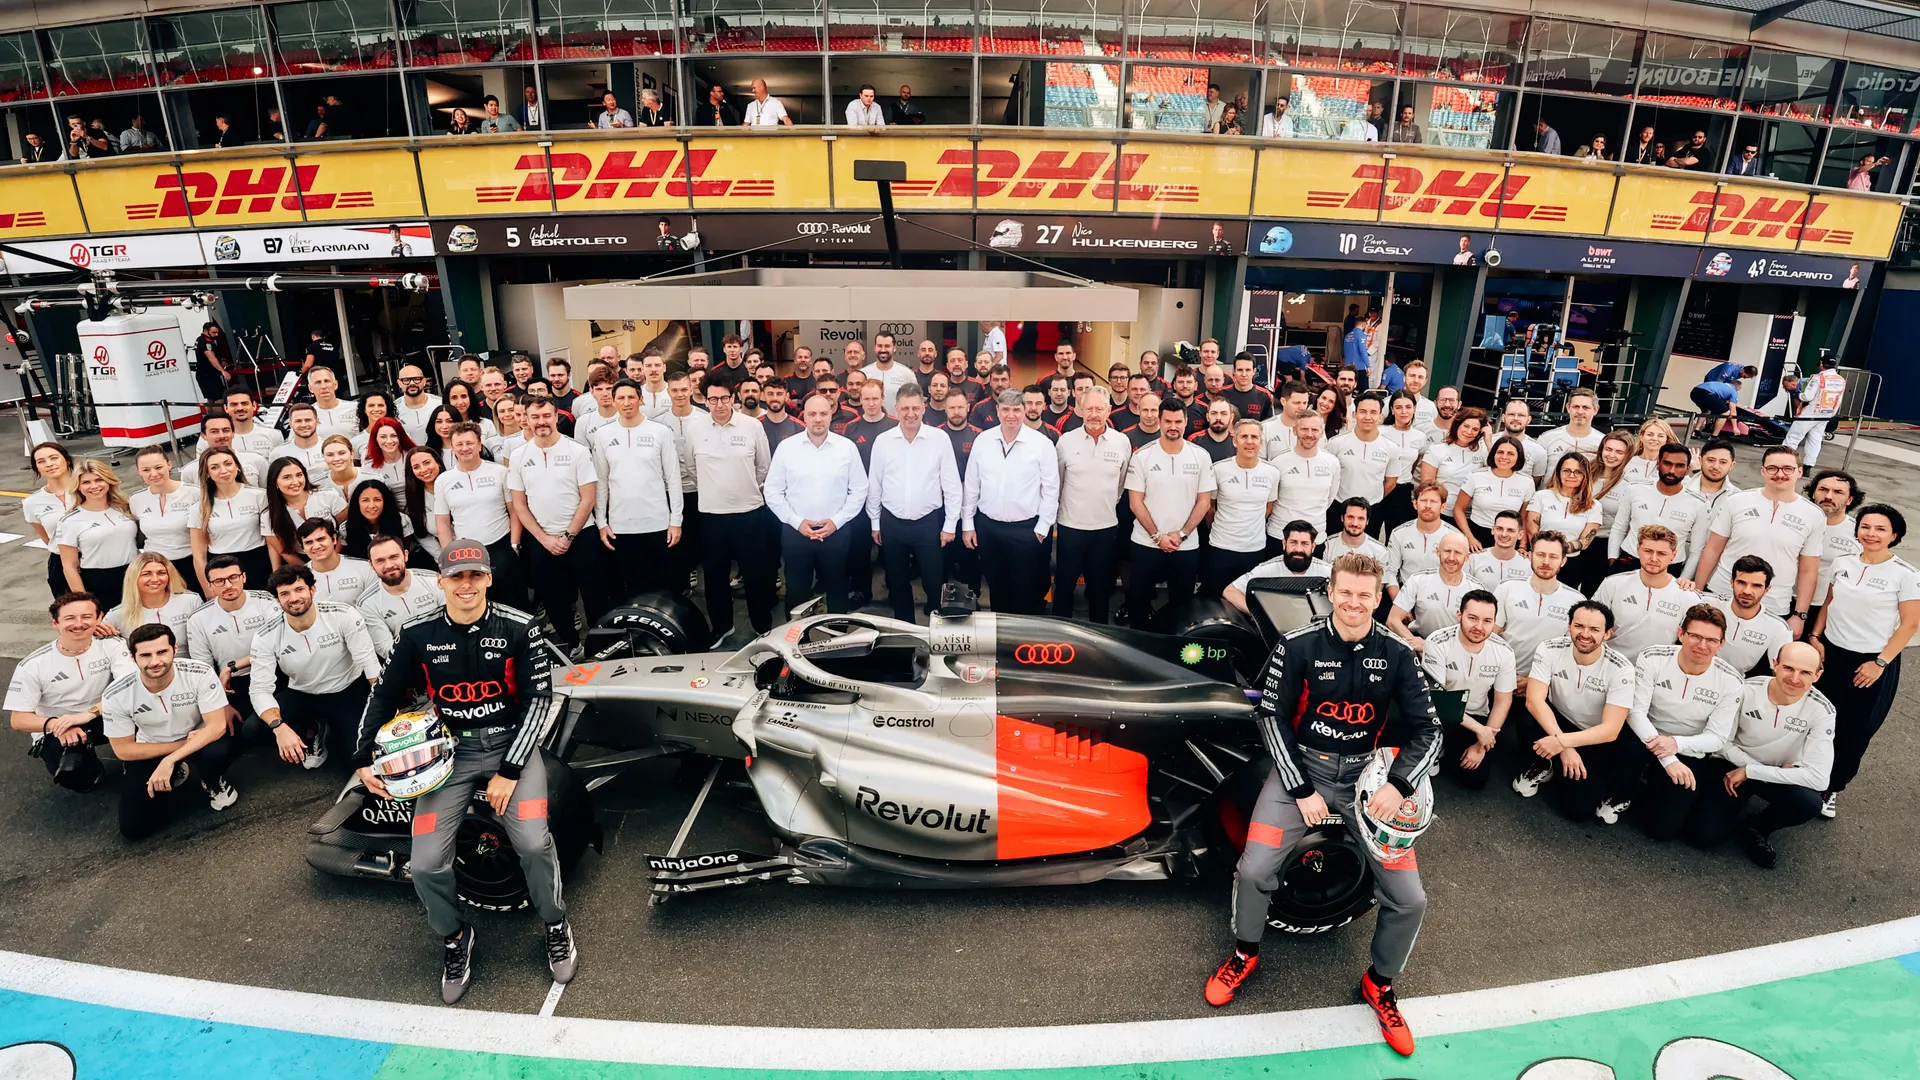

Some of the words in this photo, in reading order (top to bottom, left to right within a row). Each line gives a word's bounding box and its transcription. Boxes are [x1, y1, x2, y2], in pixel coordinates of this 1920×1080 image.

[514, 149, 733, 202] DHL
[931, 149, 1156, 202] DHL
[153, 164, 337, 219] DHL
[1344, 163, 1537, 219] DHL
[1679, 191, 1830, 242] DHL
[529, 223, 560, 240] Gabriel
[832, 223, 871, 234] Revolut
[1036, 225, 1064, 244] 27
[1072, 221, 1093, 237] Nico
[506, 227, 521, 247] 5
[531, 236, 628, 247] BORTOLETO
[1363, 234, 1388, 247] Pierre
[263, 237, 283, 254] 87
[291, 242, 370, 254] BEARMAN
[1072, 238, 1198, 249] HULKENBERG
[1339, 233, 1357, 255] 10
[89, 244, 127, 256] TGR
[1362, 246, 1413, 256] GASLY
[1595, 248, 1612, 257] BWT
[1747, 258, 1766, 278] 43
[1768, 259, 1788, 271] Franco
[1768, 269, 1833, 281] COLAPINTO
[90, 366, 116, 376] TGR
[143, 358, 177, 372] TGR
[1781, 520, 1803, 532] Revolut
[1828, 544, 1852, 554] Revolut
[1547, 612, 1568, 622] Revolut
[1656, 608, 1678, 619] Revolut
[613, 615, 623, 624] P
[627, 614, 674, 637] ZERO
[319, 639, 341, 649] Revolut
[943, 634, 971, 644] visit
[1741, 636, 1765, 646] Revolut
[426, 643, 457, 651] Revolut
[932, 644, 971, 652] QATAR
[1207, 645, 1227, 661] bp
[1314, 660, 1342, 668] Revolut
[967, 666, 977, 682] E
[806, 675, 826, 686] WORLD
[838, 683, 861, 692] HYATT
[172, 700, 197, 708] Revolut
[1693, 696, 1717, 706] Revolut
[685, 711, 733, 726] NEXO
[886, 717, 935, 728] Castrol
[388, 734, 421, 751] Revolut
[855, 785, 991, 834] Revolut
[650, 852, 738, 871] ninjaOne
